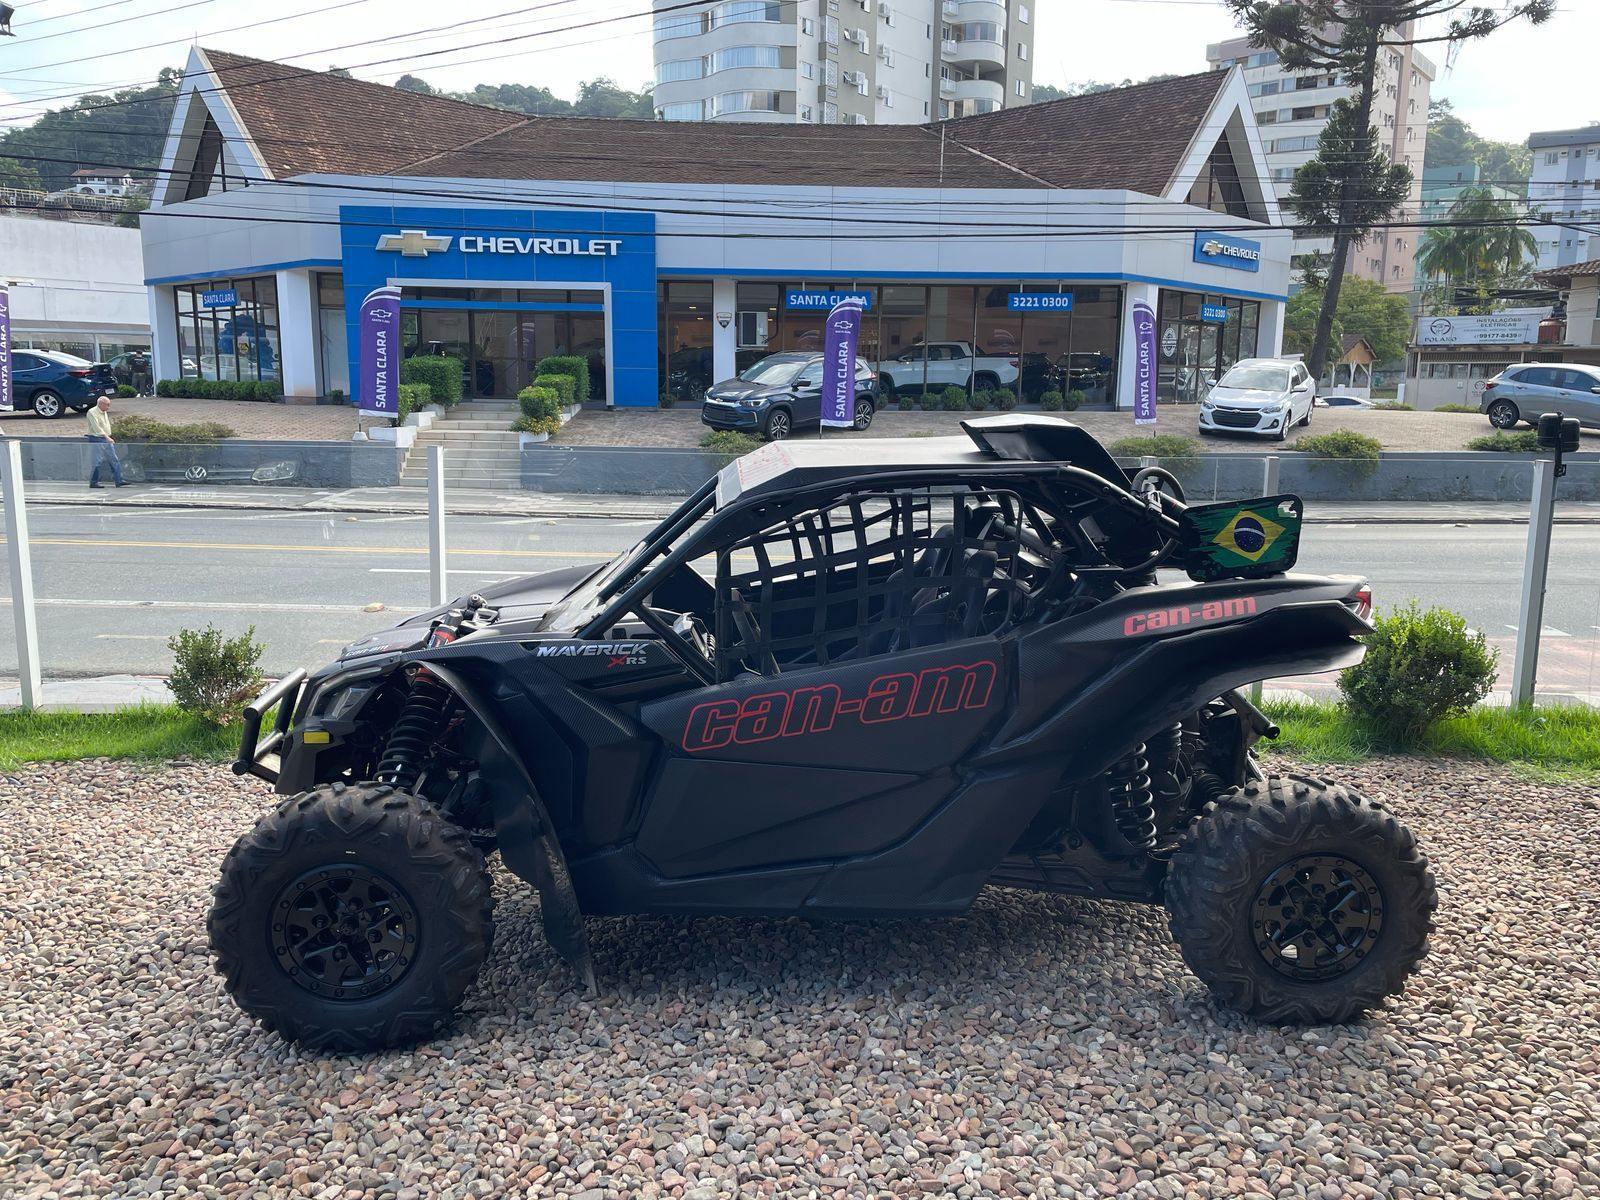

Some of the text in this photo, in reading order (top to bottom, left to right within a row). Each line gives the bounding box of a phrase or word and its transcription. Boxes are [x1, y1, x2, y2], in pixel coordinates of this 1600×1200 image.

[459, 236, 622, 256] CHEVROLET
[1223, 245, 1260, 260] CHEVROLET
[203, 293, 235, 305] SANTA CLARA
[790, 294, 827, 305] SANTA
[1013, 297, 1069, 307] 3221 0300
[0, 324, 9, 402] SANTA CLARA
[376, 330, 387, 369] CLARA
[837, 341, 848, 379] CLARA
[1141, 341, 1149, 378] CLARA
[375, 371, 387, 408] SANTA
[835, 381, 847, 418] SANTA
[1141, 380, 1150, 416] SANTA
[1123, 596, 1257, 636] can-am
[536, 643, 650, 657] MAVERICK
[682, 660, 996, 751] can-am
